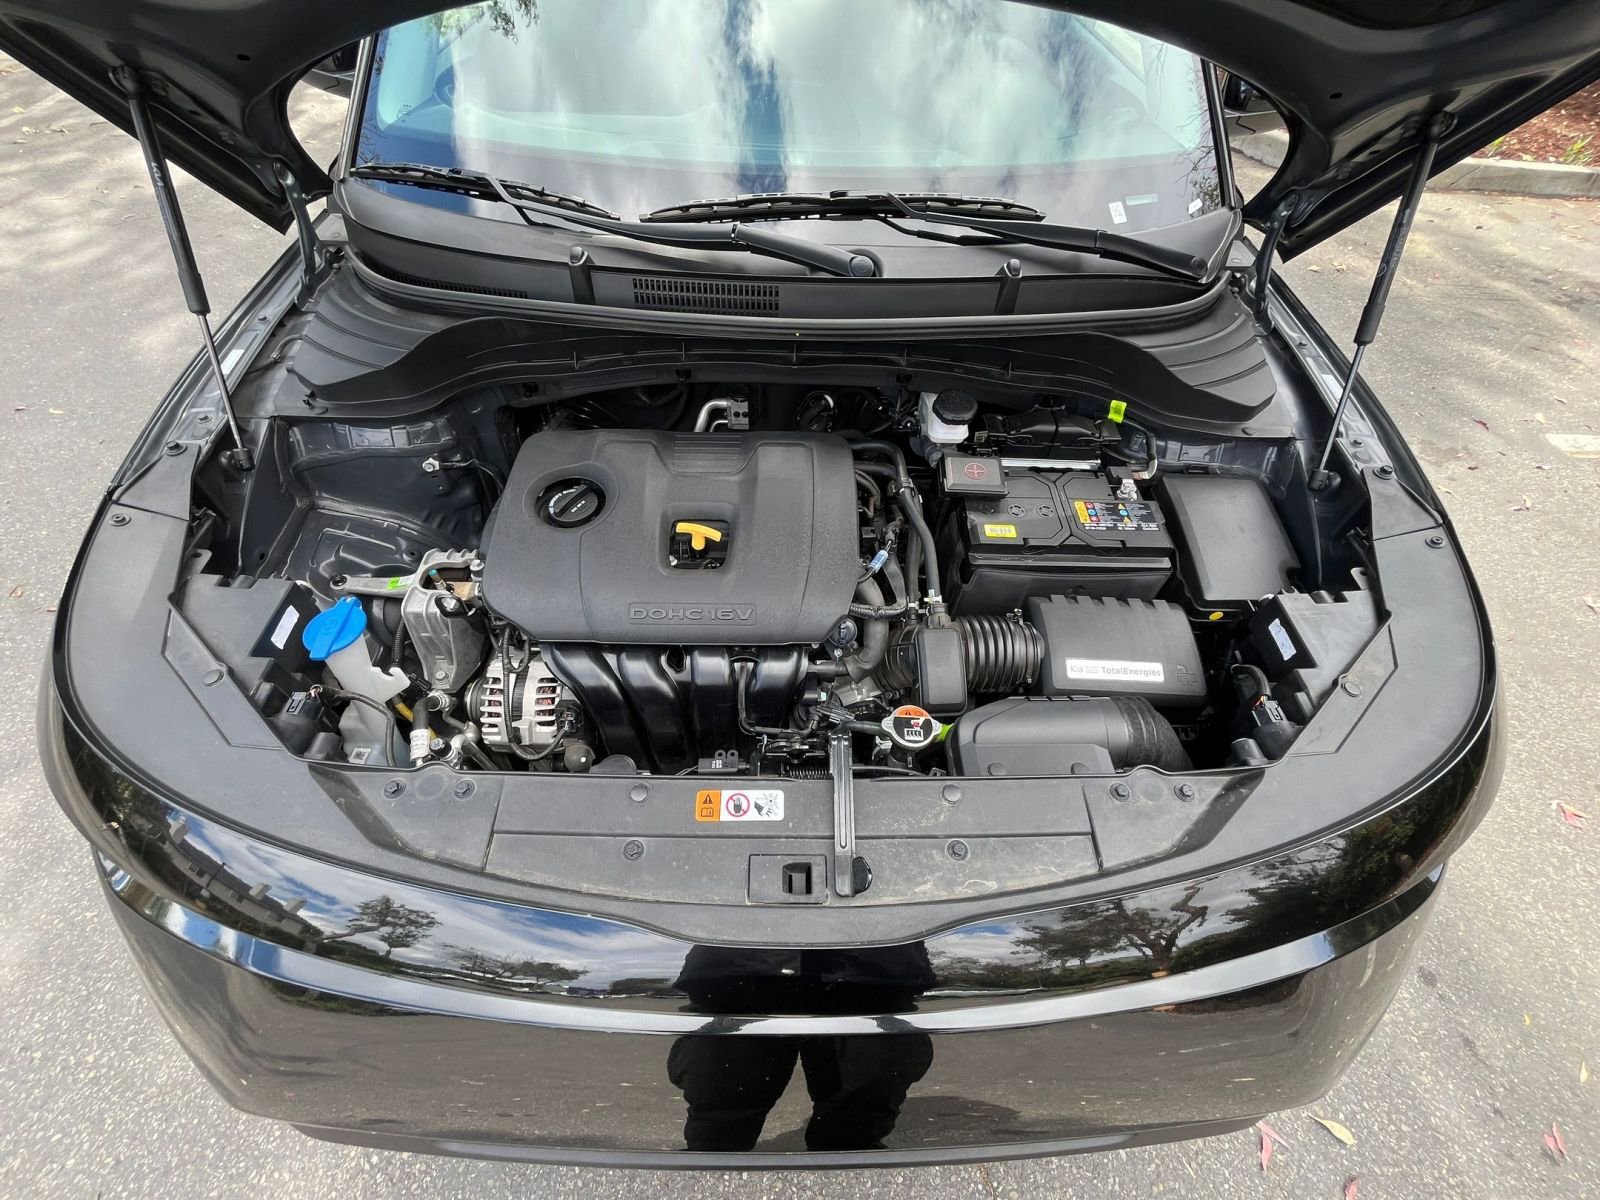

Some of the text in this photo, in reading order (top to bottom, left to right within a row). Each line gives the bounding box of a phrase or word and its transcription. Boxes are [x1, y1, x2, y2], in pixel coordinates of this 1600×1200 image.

[630, 607, 754, 621] DOHC 16V
[1101, 666, 1161, 678] TotalEnergies
